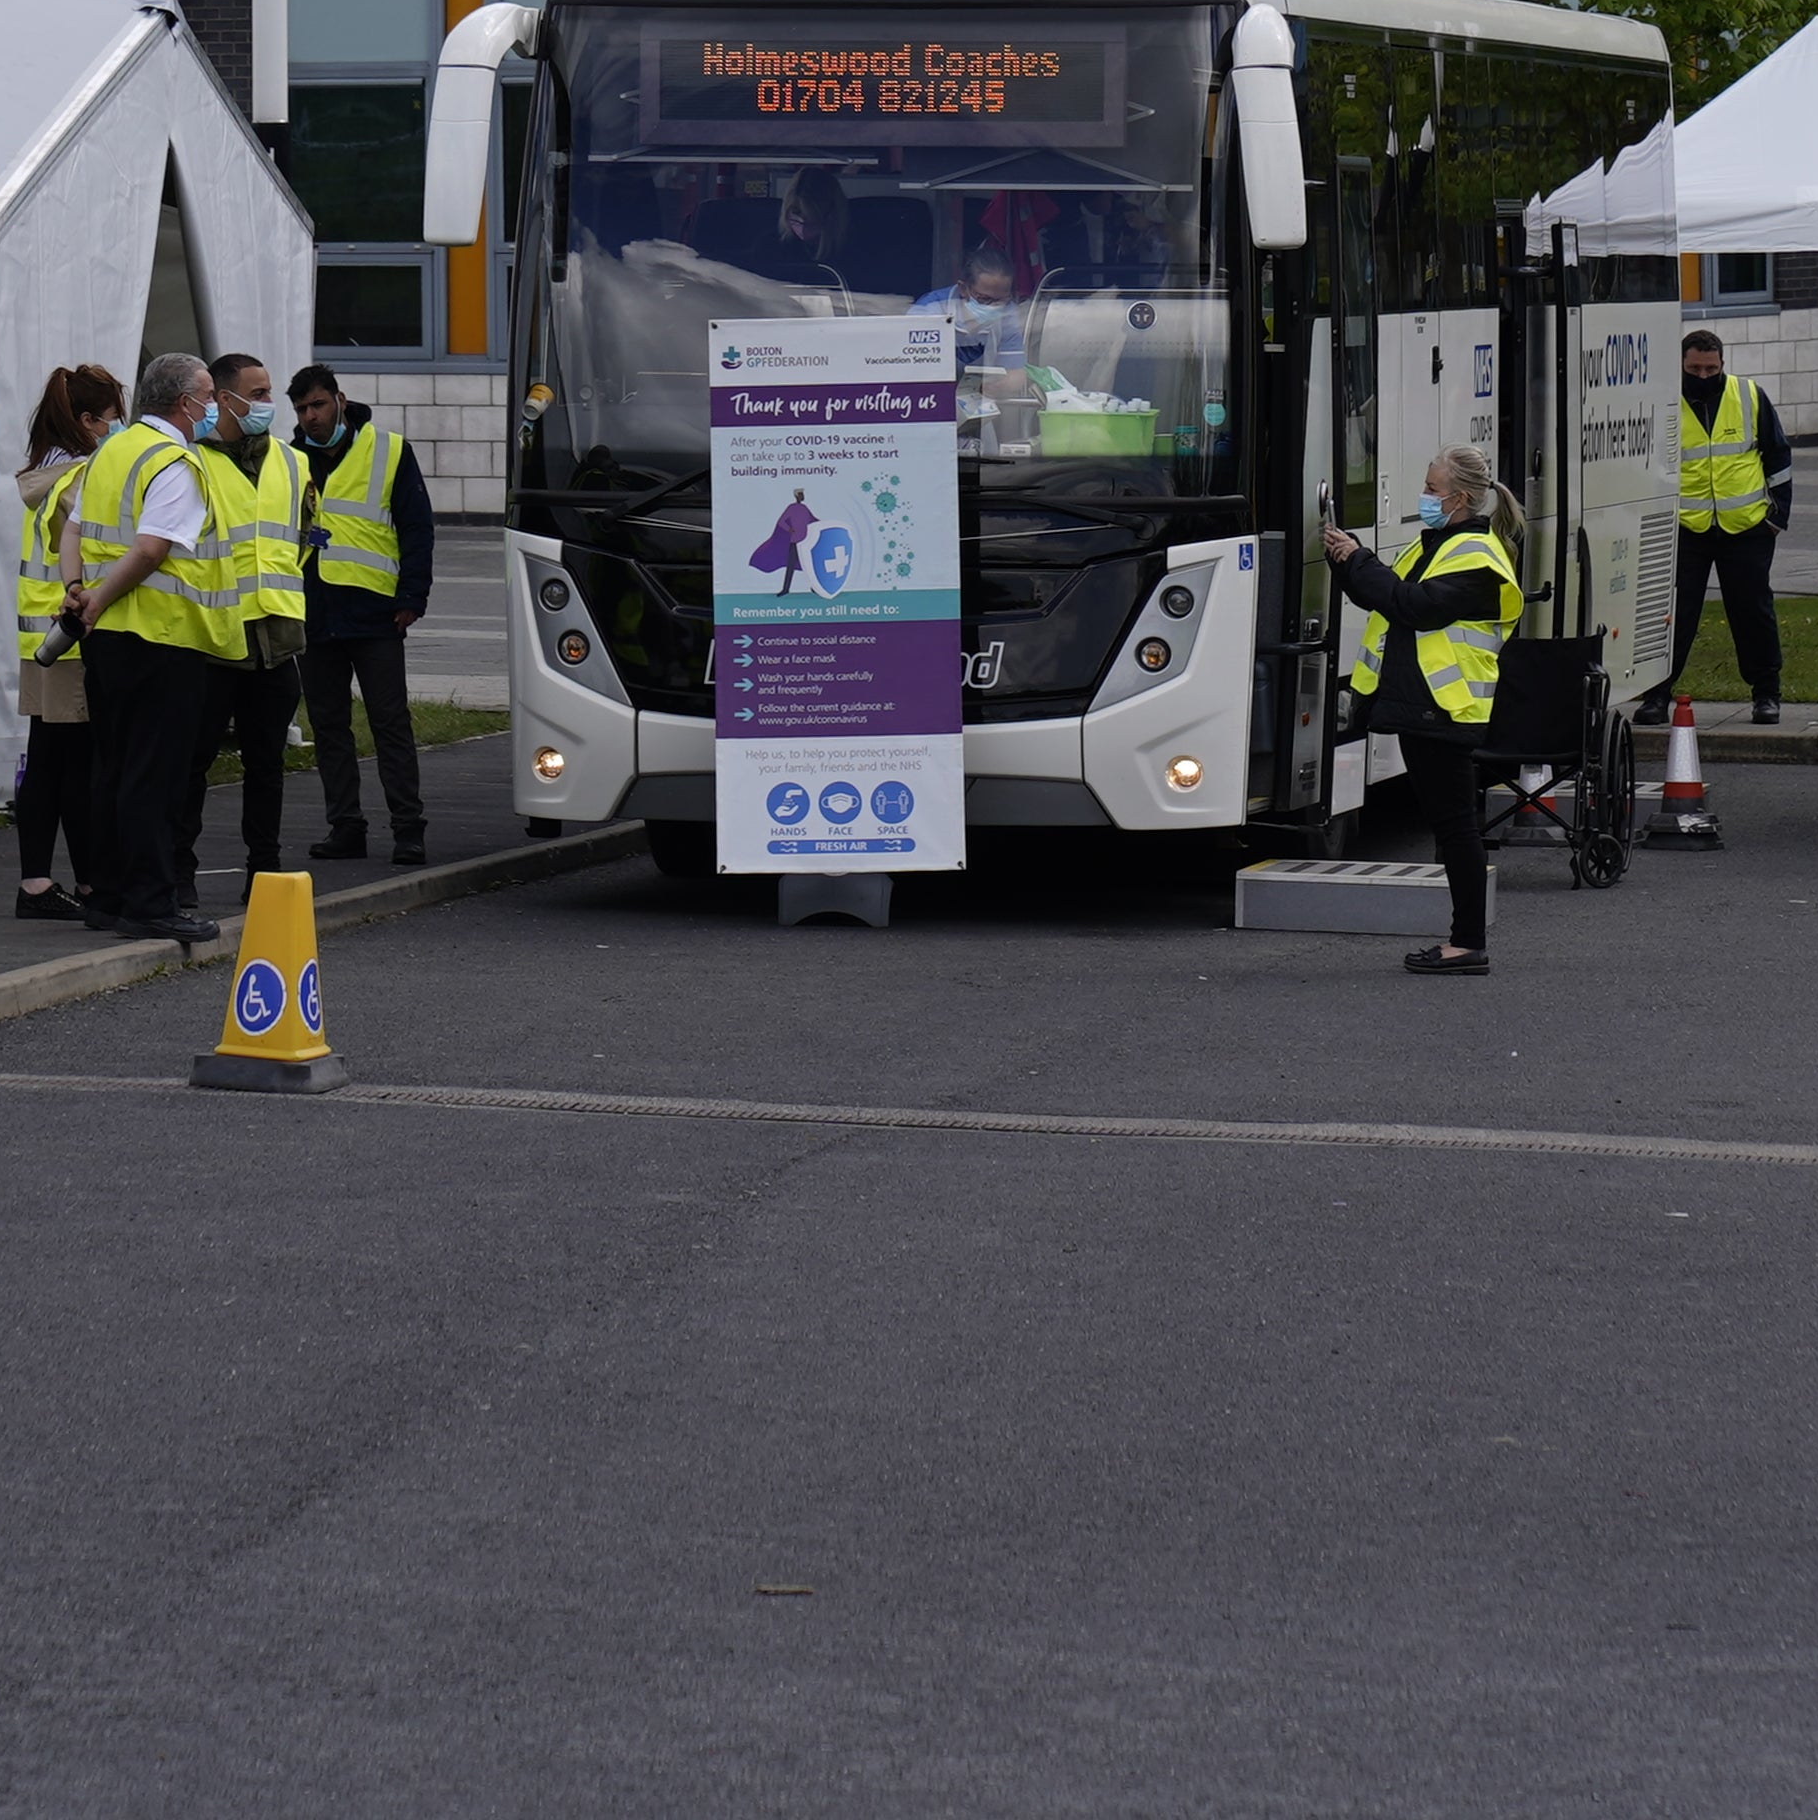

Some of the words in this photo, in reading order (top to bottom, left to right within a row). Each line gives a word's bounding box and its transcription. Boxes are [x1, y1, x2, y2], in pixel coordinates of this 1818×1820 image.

[702, 42, 911, 76] Holmeswood
[924, 44, 1061, 77] Coaches
[757, 80, 865, 113] 01704
[878, 80, 1006, 113] 821245
[910, 331, 940, 343] NHS
[746, 347, 782, 355] BOLTON
[746, 356, 829, 367] GPFEDERATION
[1582, 348, 1603, 404] your
[1606, 332, 1647, 386] COVID-19
[730, 392, 783, 416] Thank
[790, 399, 817, 417] you
[825, 399, 848, 420] for
[855, 386, 911, 418] visiting
[919, 394, 937, 409] us
[1607, 404, 1626, 459] here
[1628, 401, 1654, 469] today!
[731, 437, 756, 447] After
[760, 439, 782, 448] your
[786, 436, 840, 445] COVID-19
[843, 435, 884, 444] vaccine
[888, 435, 894, 443] it
[752, 451, 774, 461] take
[778, 453, 791, 462] up
[794, 452, 805, 460] to
[808, 451, 814, 460] 3
[818, 450, 854, 459] weeks
[858, 451, 869, 459] to
[873, 450, 899, 458] start
[731, 466, 777, 478] building
[781, 465, 837, 477] immunity.
[734, 607, 796, 618] Remember
[800, 608, 822, 619] you
[825, 605, 847, 616] still
[850, 605, 879, 615] need
[883, 605, 899, 614] to:
[757, 637, 799, 646] Continue
[801, 637, 810, 645] to
[813, 636, 837, 645] social
[839, 636, 876, 644] distance
[757, 656, 781, 664] Wear
[792, 655, 810, 663] face
[813, 654, 836, 663] mask
[758, 674, 782, 682] Wash
[784, 675, 805, 683] your
[807, 672, 834, 681] hands
[836, 671, 873, 681] carefully
[758, 686, 775, 694] and
[778, 685, 823, 695] frequently
[758, 703, 788, 712] Follow
[790, 703, 805, 712] the
[807, 703, 839, 711] current
[841, 702, 881, 712] guidance
[759, 715, 868, 726] www.gov.uk/coronavirus
[745, 750, 769, 761] Help
[771, 751, 786, 759] us,
[790, 750, 800, 758] to
[803, 749, 825, 759] help
[828, 750, 847, 759] you
[850, 748, 885, 758] protect
[888, 747, 931, 758] yourself,
[759, 765, 782, 775] your
[785, 763, 817, 774] family,
[820, 762, 855, 772] friends
[860, 762, 877, 771] and
[881, 762, 897, 771] the
[900, 762, 922, 770] NHS
[771, 828, 807, 836] HANDS
[828, 827, 853, 835] FACE
[877, 826, 908, 835] SPACE
[815, 842, 848, 851] FRESH
[850, 842, 867, 850] AIR
